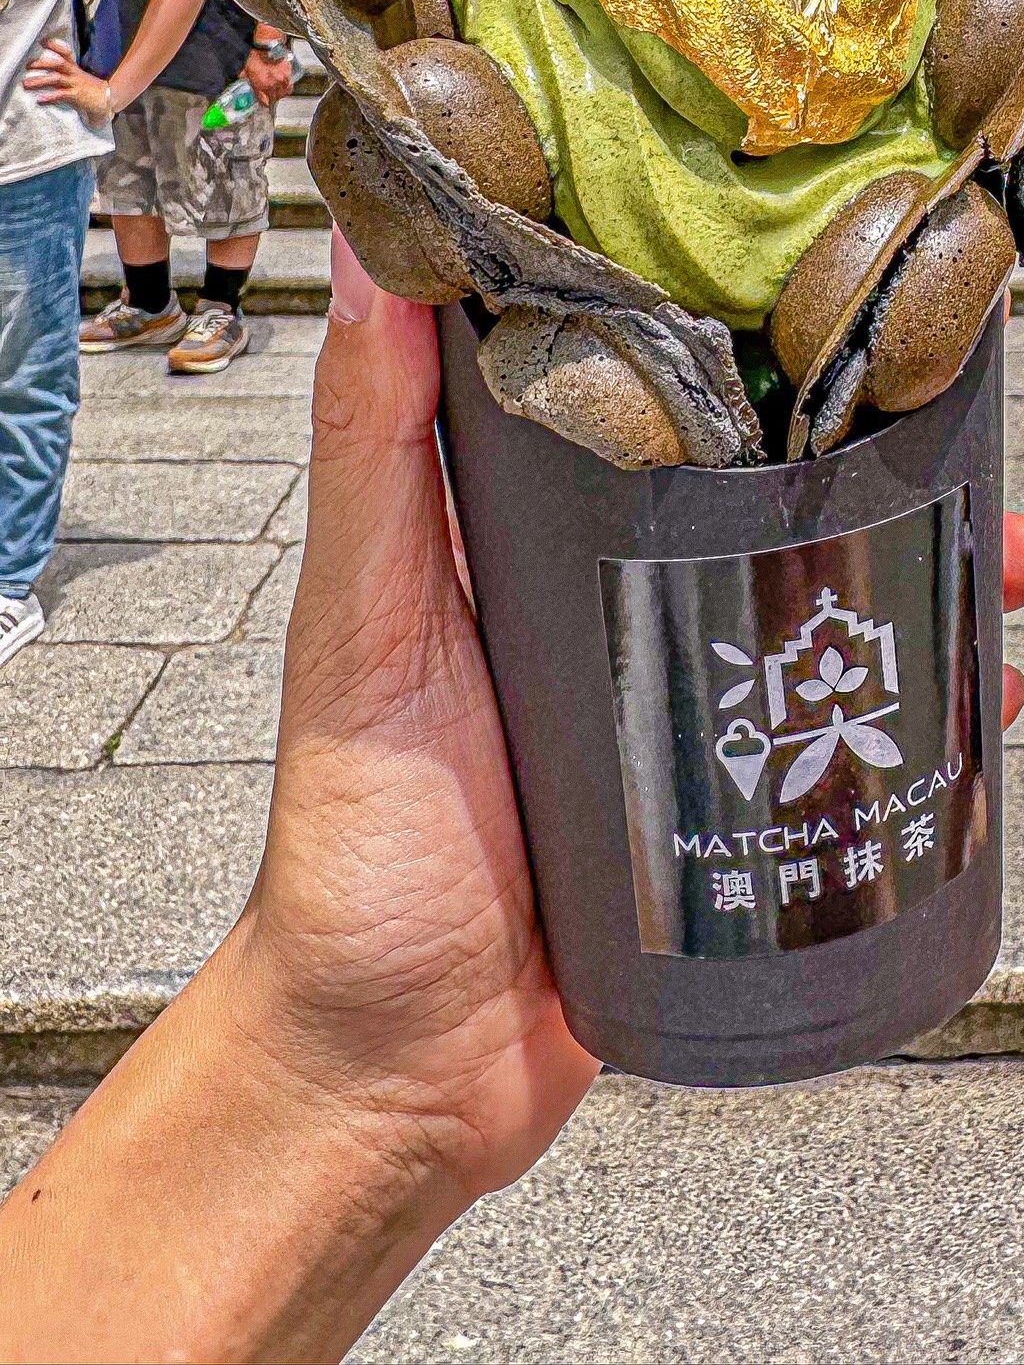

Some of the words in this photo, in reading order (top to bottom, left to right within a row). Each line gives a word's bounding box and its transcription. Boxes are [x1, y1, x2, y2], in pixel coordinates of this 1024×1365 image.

[672, 817, 839, 860] MATCHA
[853, 752, 964, 833] MACAU
[711, 811, 937, 912] 澳門抹茶
